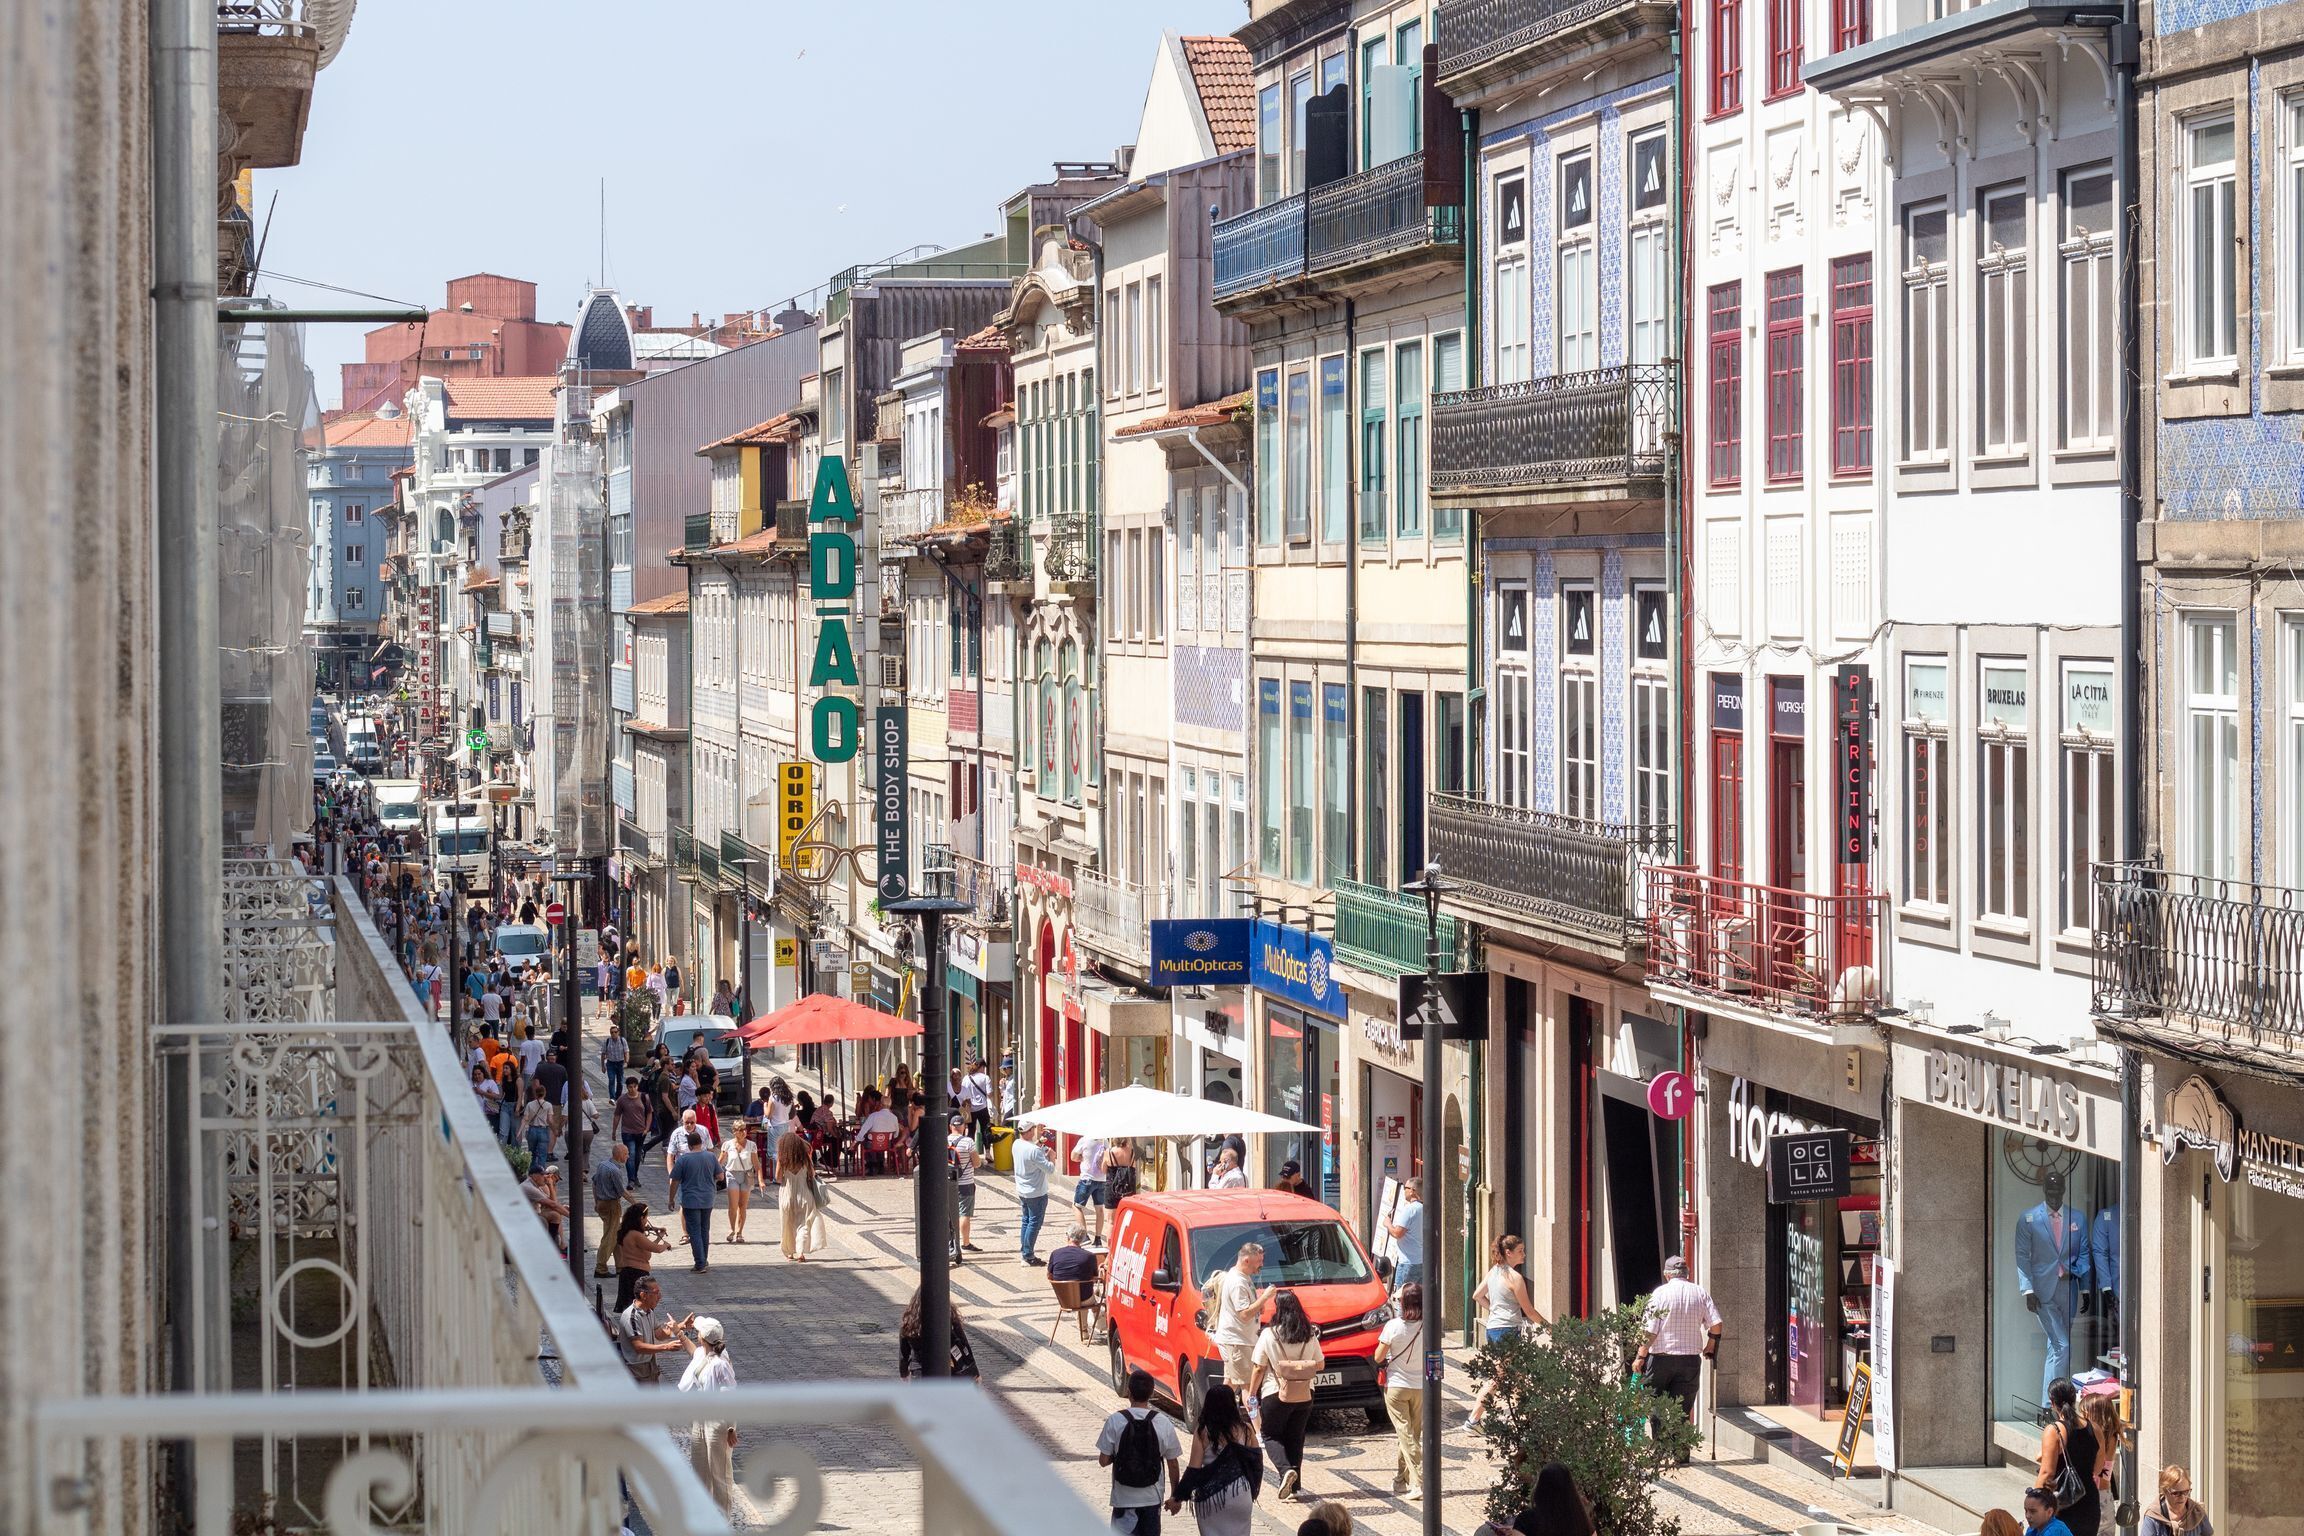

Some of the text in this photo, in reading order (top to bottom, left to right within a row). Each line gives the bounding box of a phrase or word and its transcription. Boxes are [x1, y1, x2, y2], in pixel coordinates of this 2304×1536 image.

[420, 587, 431, 718] PERFECTA
[1919, 690, 1944, 699] FIRENZE
[1987, 688, 2026, 706] BRUXELAS
[2071, 682, 2108, 702] LA CITTÀ
[1848, 674, 1860, 853] PIERCING
[787, 766, 804, 831] OURO
[885, 718, 900, 865] THE BODY SHOP
[1159, 958, 1243, 974] MultiOpticas
[1264, 943, 1308, 986] MultiOpticas
[1930, 1047, 2080, 1141] BRUXELAS
[2272, 1179, 2282, 1194] de
